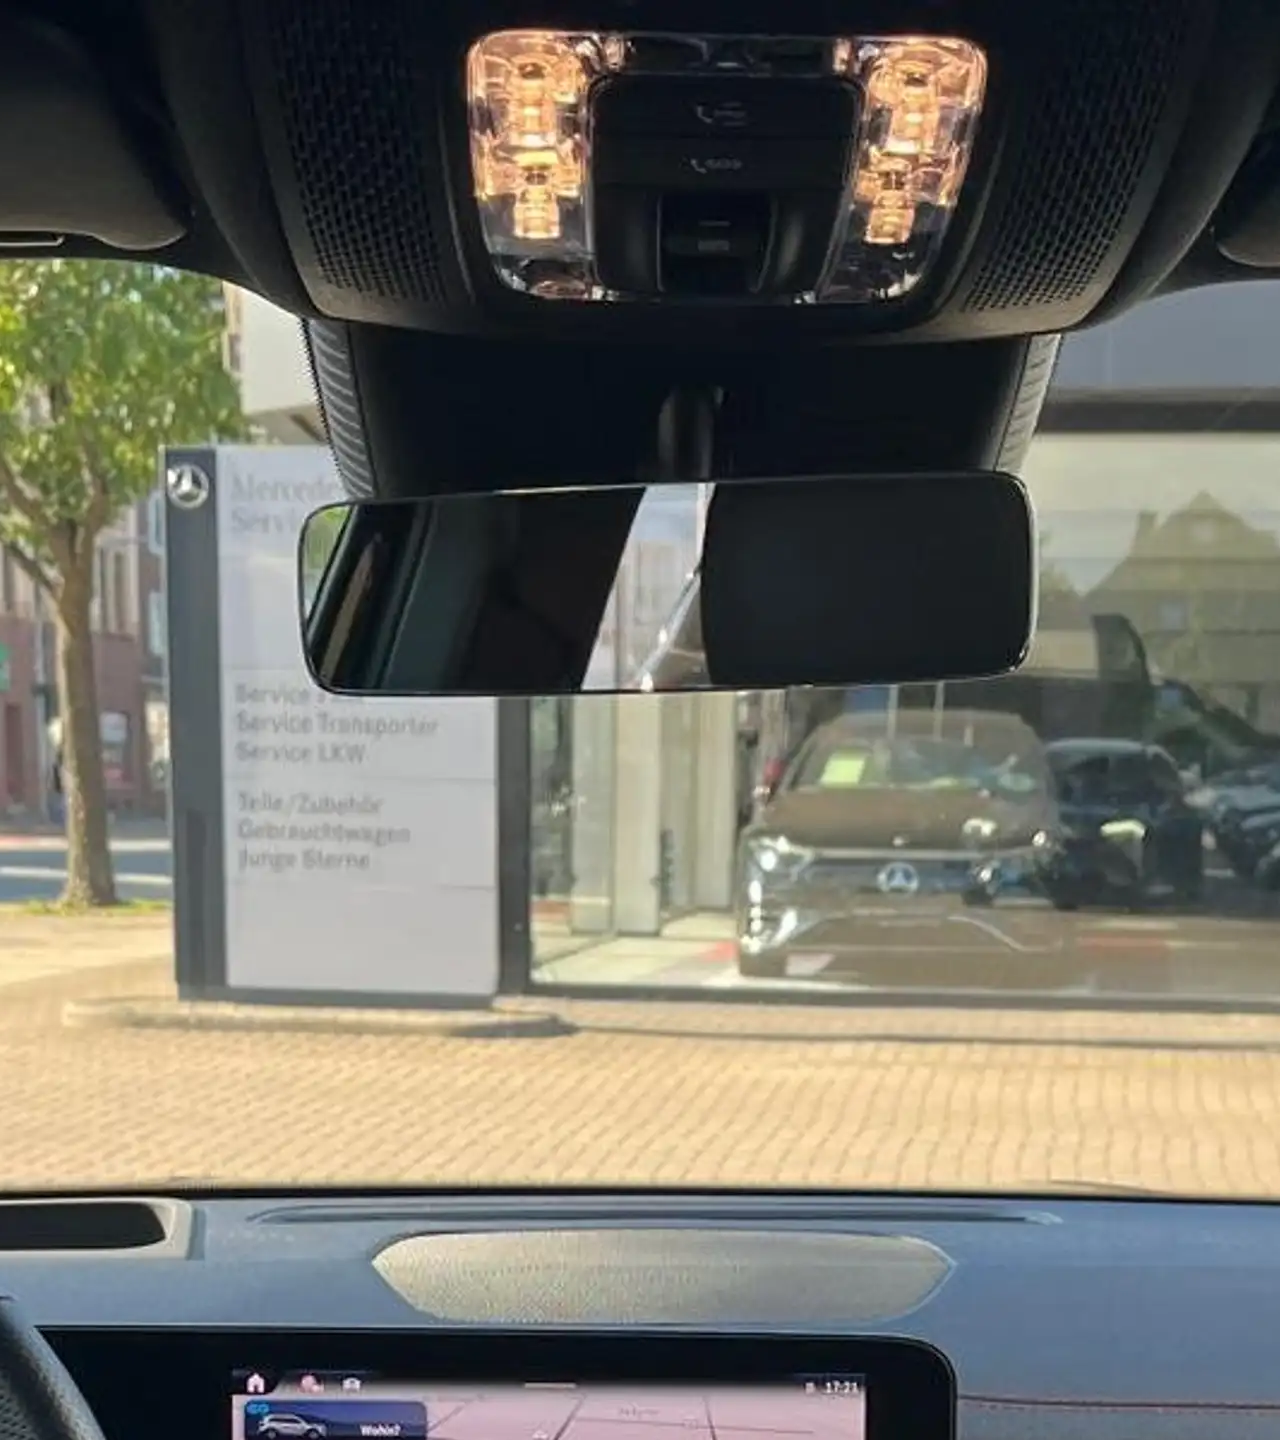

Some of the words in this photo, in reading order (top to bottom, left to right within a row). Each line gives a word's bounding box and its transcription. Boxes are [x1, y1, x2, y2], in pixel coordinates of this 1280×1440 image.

[234, 711, 314, 736] Service
[318, 712, 439, 740] Transporter
[234, 741, 314, 763] Service
[319, 742, 368, 764] LKW
[237, 818, 411, 848] Gebrauchtwagen
[237, 847, 297, 873] Junge
[302, 848, 371, 871] Sterne
